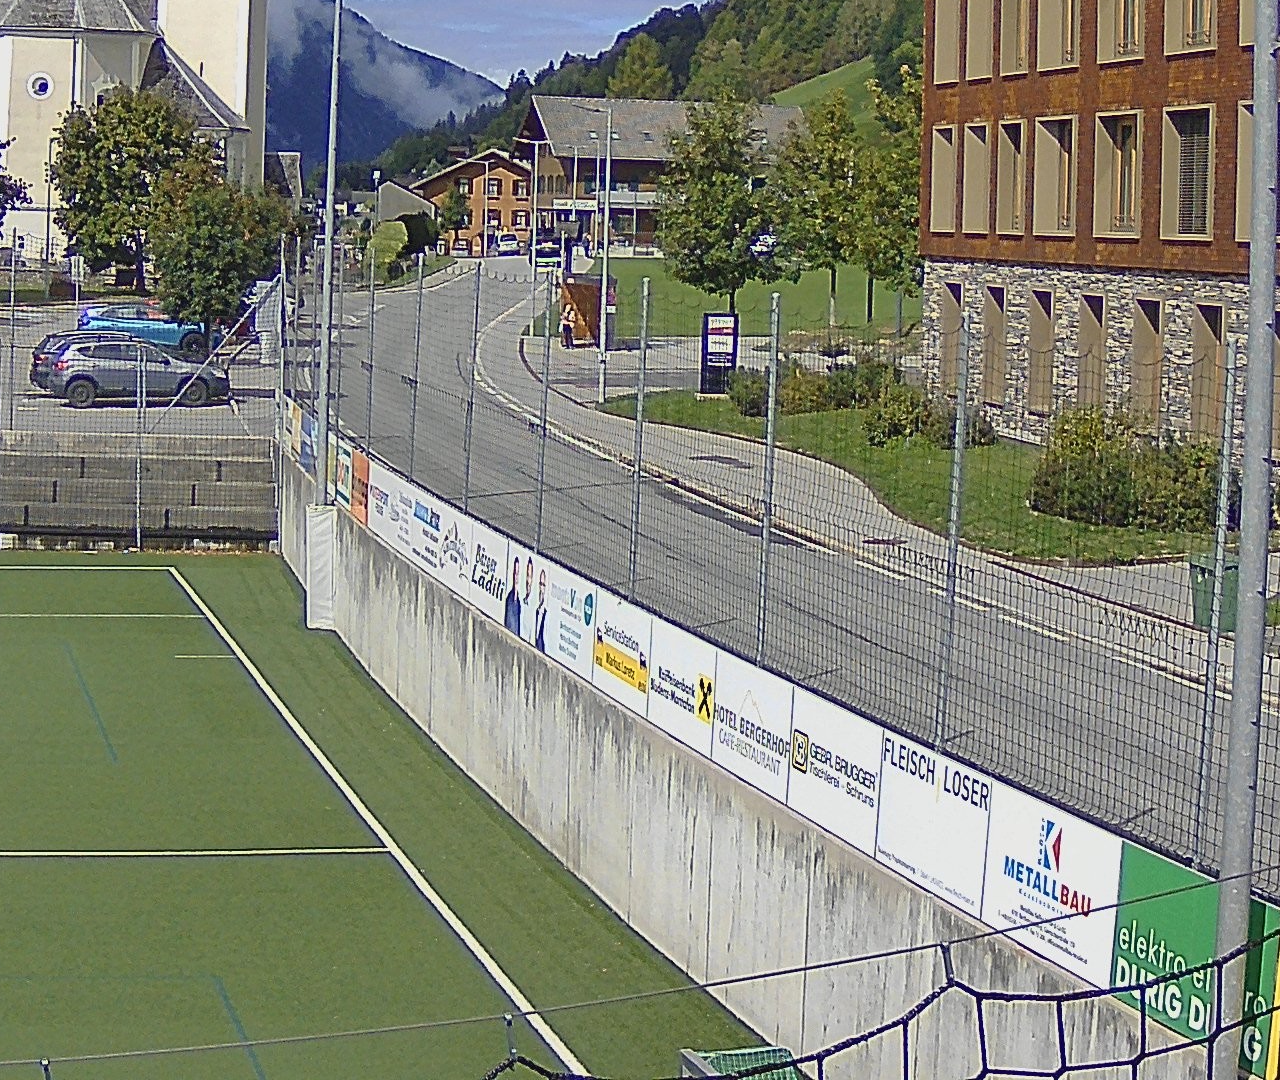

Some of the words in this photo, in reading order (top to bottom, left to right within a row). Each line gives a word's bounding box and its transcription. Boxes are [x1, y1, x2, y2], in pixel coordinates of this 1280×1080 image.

[713, 703, 738, 731] HOTEL
[739, 717, 790, 759] BERGERHOF
[809, 760, 840, 789] Tischlerei
[834, 754, 876, 792] BRUGGER
[883, 737, 936, 786] FLEISCH
[943, 765, 990, 812] LOSER
[1003, 855, 1092, 918] METALLBAU
[1119, 920, 1187, 973] elektro
